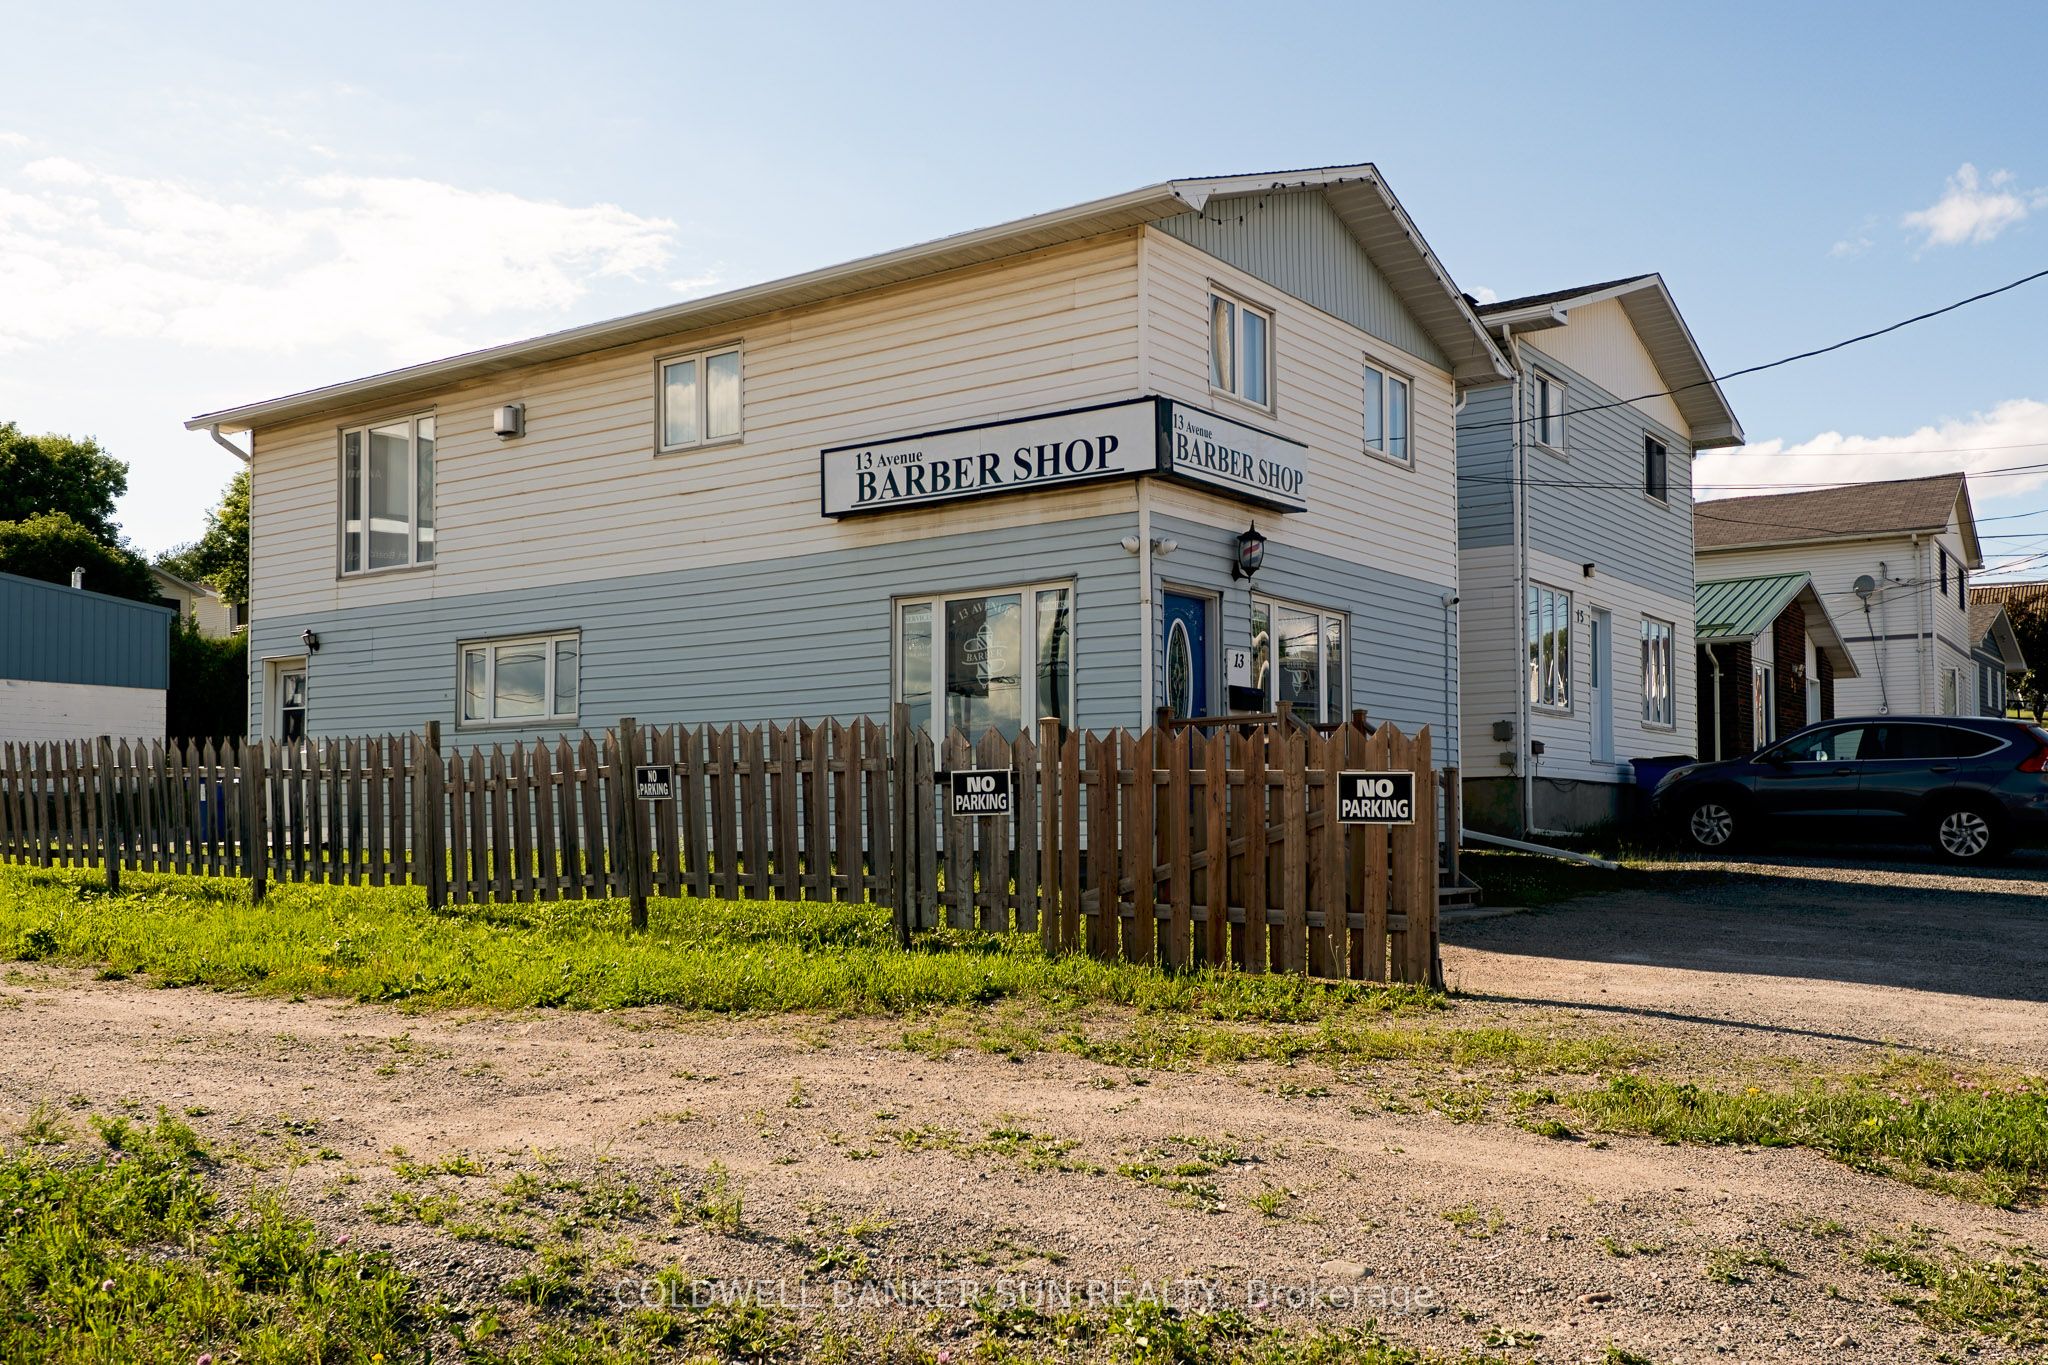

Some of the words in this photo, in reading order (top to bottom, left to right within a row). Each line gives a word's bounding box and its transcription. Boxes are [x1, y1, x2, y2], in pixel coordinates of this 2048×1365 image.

[1173, 413, 1184, 431] 13
[1186, 421, 1213, 440] Avenue
[855, 451, 873, 470] 13
[877, 451, 923, 468] Avenue
[856, 453, 1003, 503] BARBER
[1013, 435, 1119, 482] SHOP
[1176, 432, 1254, 481] BARBER
[1259, 458, 1303, 495] SHOP
[959, 608, 969, 620] 13
[1233, 653, 1245, 669] 13
[647, 770, 658, 783] NO
[966, 775, 996, 793] NO
[639, 782, 669, 796] PARKING
[1356, 778, 1395, 798] NO
[955, 793, 1007, 811] PARKING
[1342, 799, 1409, 818] PARKING
